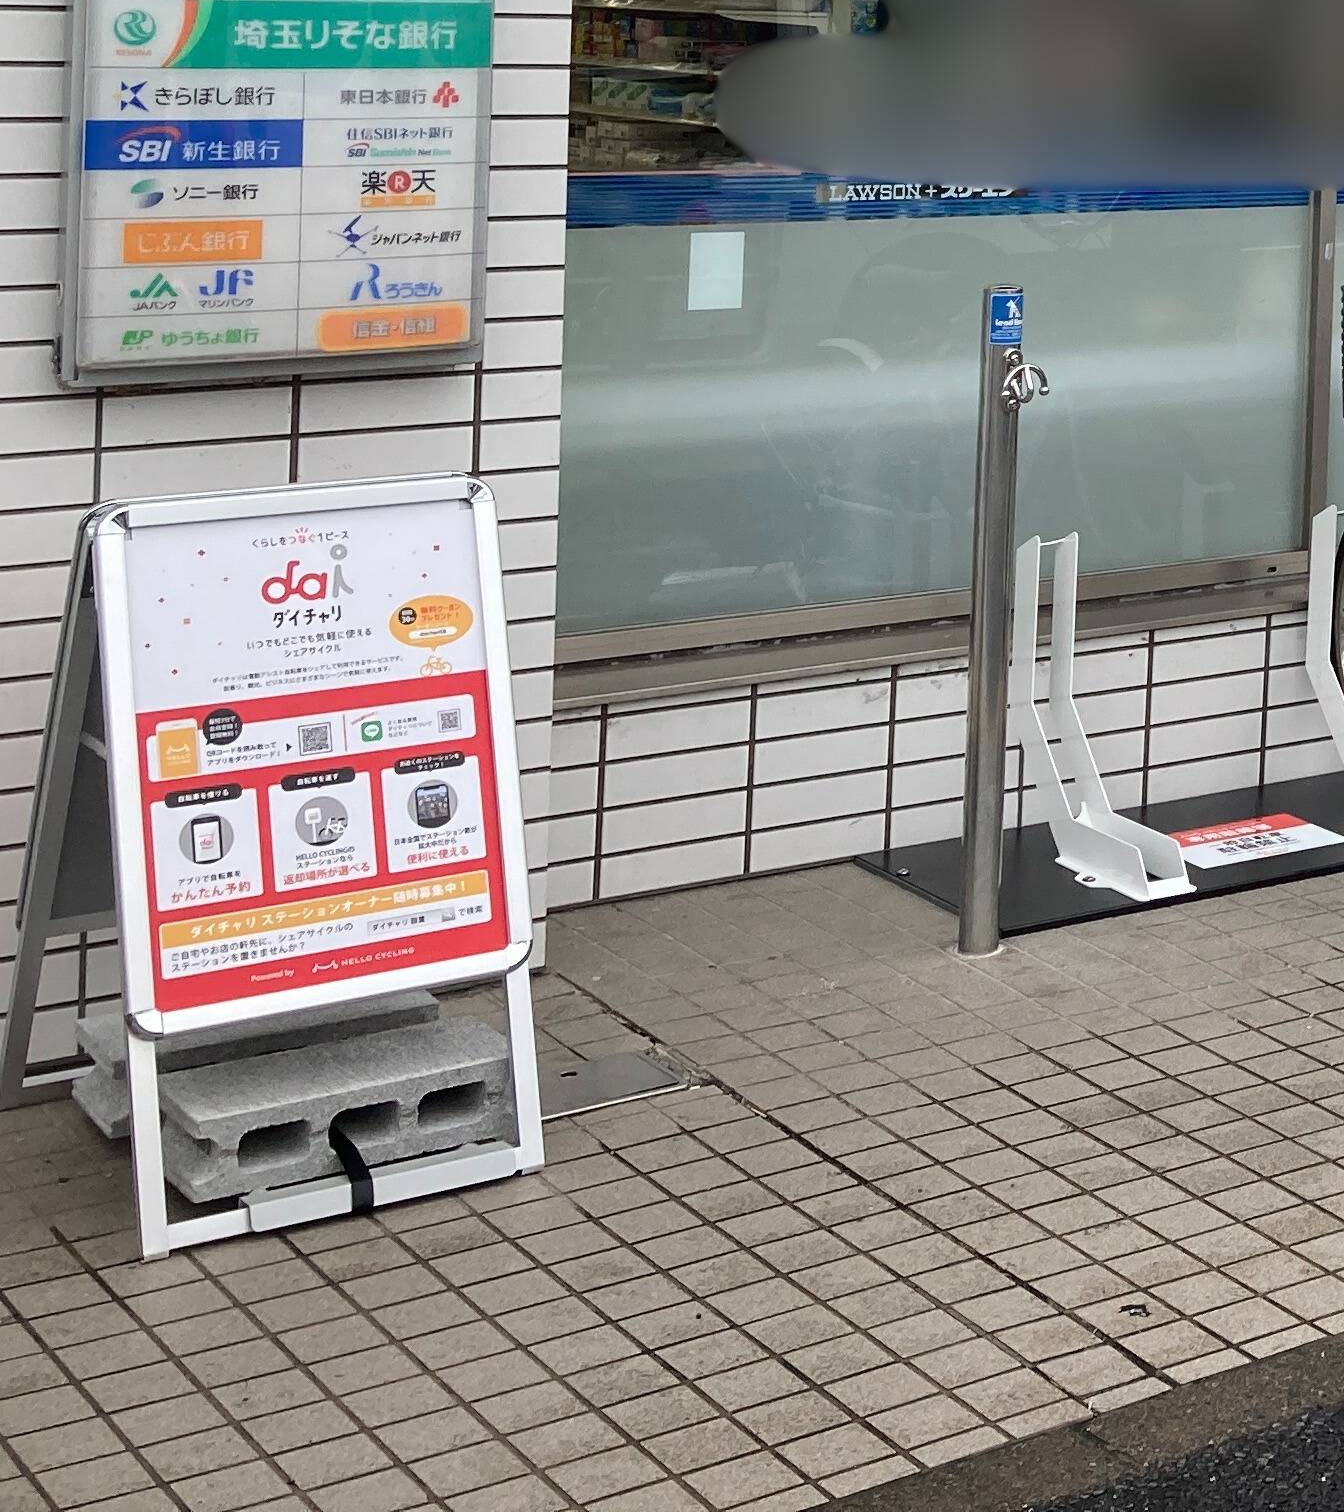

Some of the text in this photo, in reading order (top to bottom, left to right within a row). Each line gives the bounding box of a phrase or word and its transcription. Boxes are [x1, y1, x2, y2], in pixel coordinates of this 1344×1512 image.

[234, 18, 458, 51] 埼玉りそな銀行
[154, 85, 427, 107] きらぼし銀行 東日本銀行
[346, 126, 453, 141] 住信SBIネット銀行
[118, 138, 280, 163] SBI 新生銀行
[172, 182, 259, 202] ソニー銀行
[829, 184, 921, 201] LAWSON
[371, 230, 462, 246] ジャパンネット銀行
[385, 282, 442, 299] ろうきん
[132, 298, 254, 311] JAバンク マリンバンク
[161, 328, 260, 346] ゆうちょ銀行
[352, 317, 437, 339] 信金・信組
[272, 605, 343, 629] ダイチャリ
[246, 628, 373, 650] いつでもどこでも気軽に使える
[283, 644, 342, 658] シェアサイクル
[282, 860, 371, 887] 返却場所が選べる
[171, 881, 251, 903] かんたん予約
[189, 915, 257, 939] ダイチャリ
